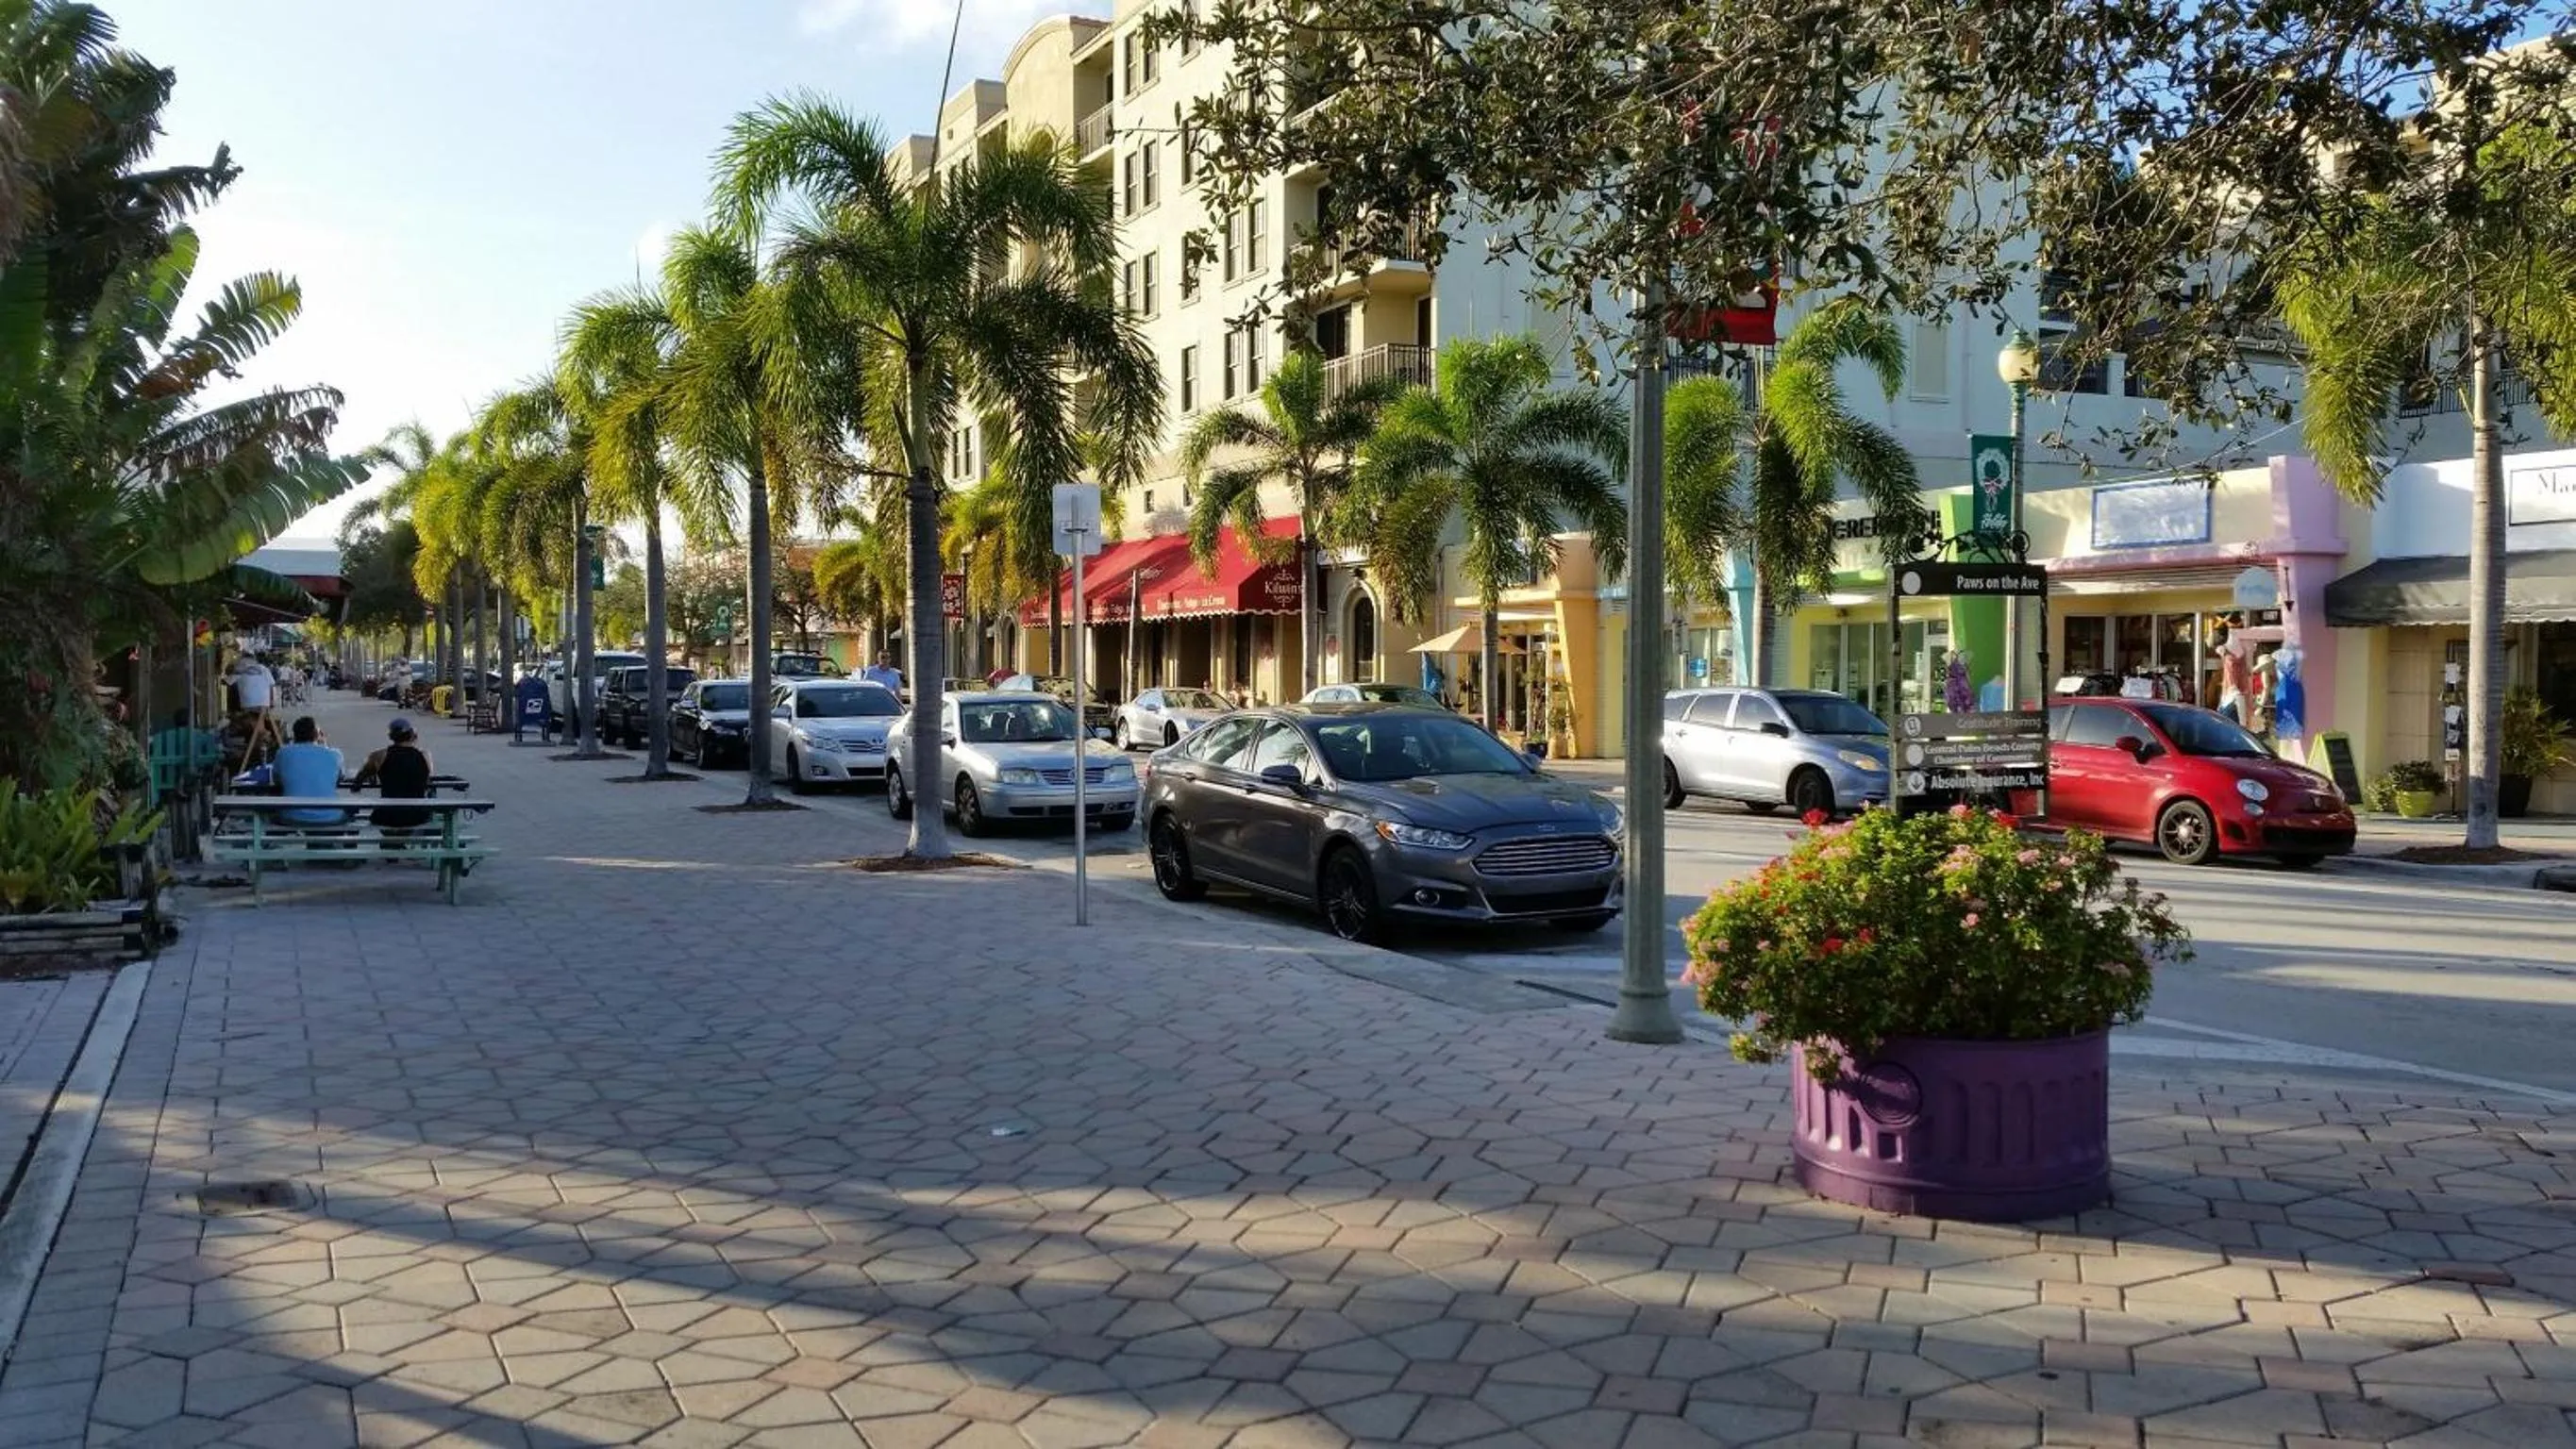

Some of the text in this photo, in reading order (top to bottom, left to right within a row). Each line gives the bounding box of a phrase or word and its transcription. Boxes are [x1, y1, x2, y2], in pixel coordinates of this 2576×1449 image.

[1956, 575, 2039, 590] Paws on the Ave
[1924, 744, 1956, 755] Central
[1982, 743, 2010, 753] Beach
[2011, 741, 2042, 752] County
[1931, 774, 1977, 789] Absolute
[2029, 772, 2044, 785] Inc
